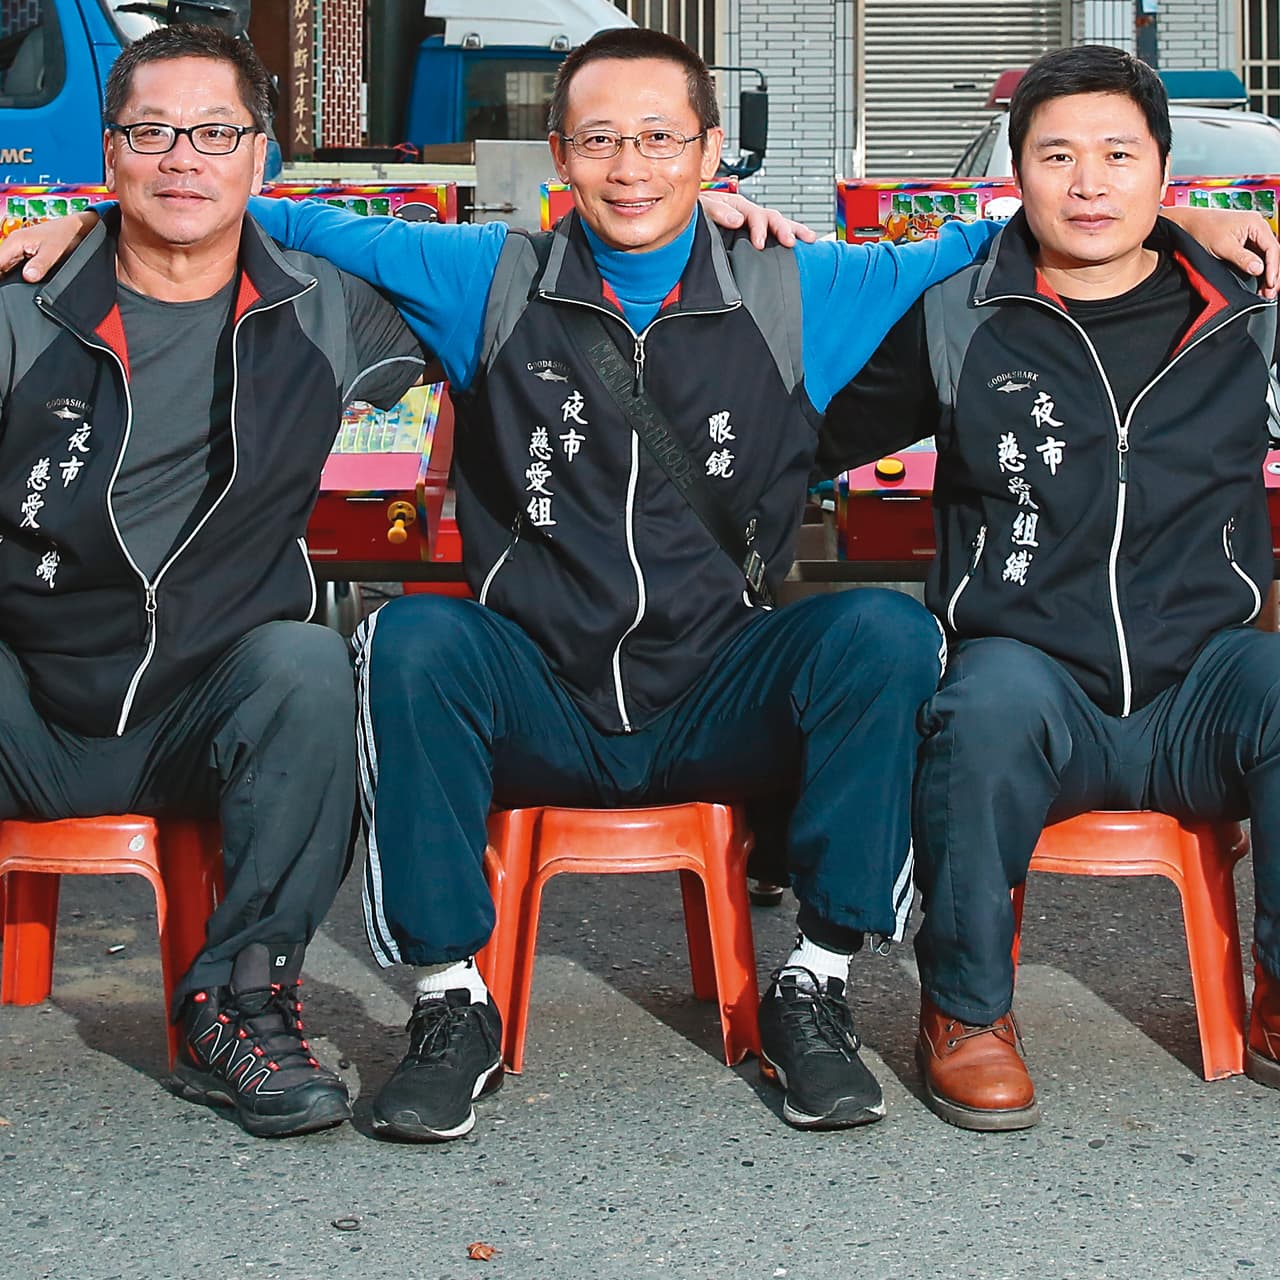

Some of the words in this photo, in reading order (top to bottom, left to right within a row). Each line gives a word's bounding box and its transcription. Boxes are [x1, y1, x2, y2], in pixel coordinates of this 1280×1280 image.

[59, 422, 92, 488] 夜市
[559, 390, 588, 462] 夜市
[705, 410, 737, 478] 眼鏡
[1030, 391, 1066, 476] 夜市
[20, 457, 61, 589] 慈愛織
